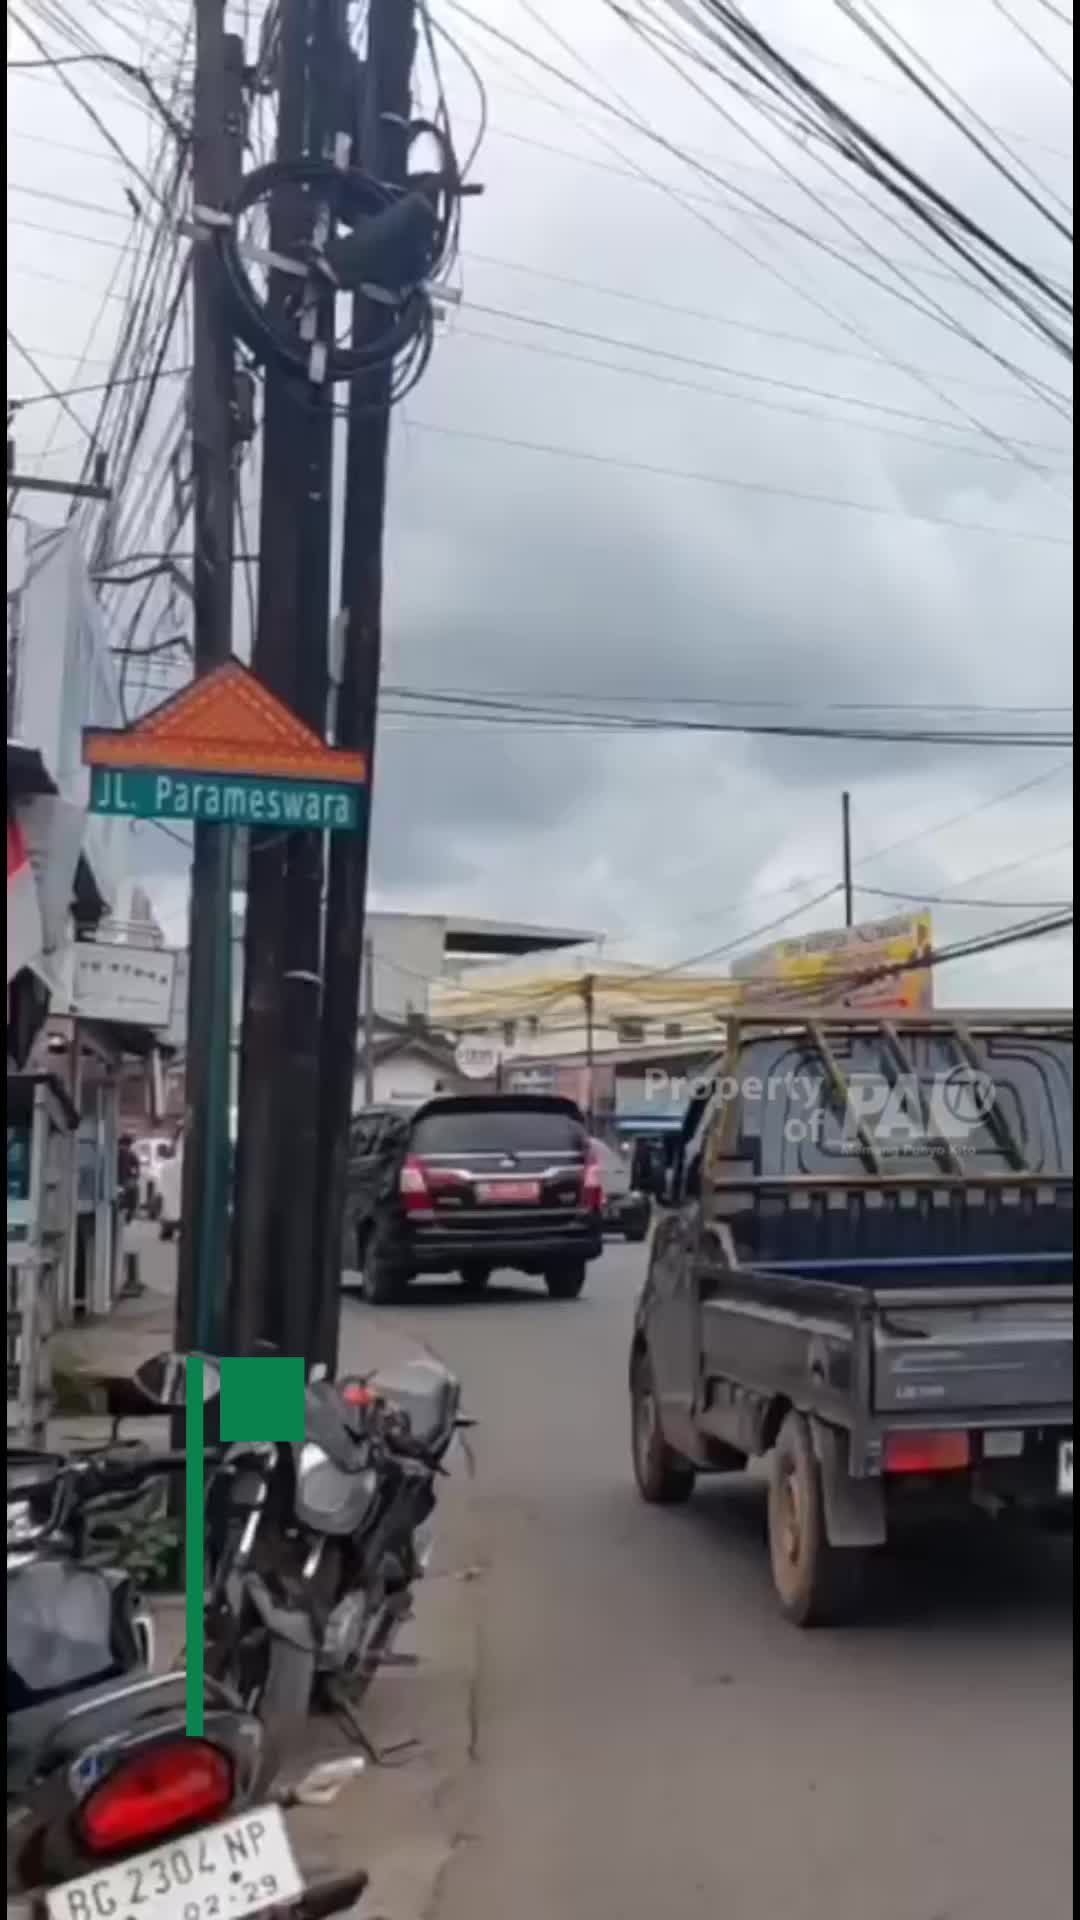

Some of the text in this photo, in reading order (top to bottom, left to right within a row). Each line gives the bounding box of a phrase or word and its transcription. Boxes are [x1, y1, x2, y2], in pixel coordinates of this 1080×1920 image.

[97, 773, 351, 823] JL. Parameswara
[67, 1821, 265, 1920] BG 2304 NP
